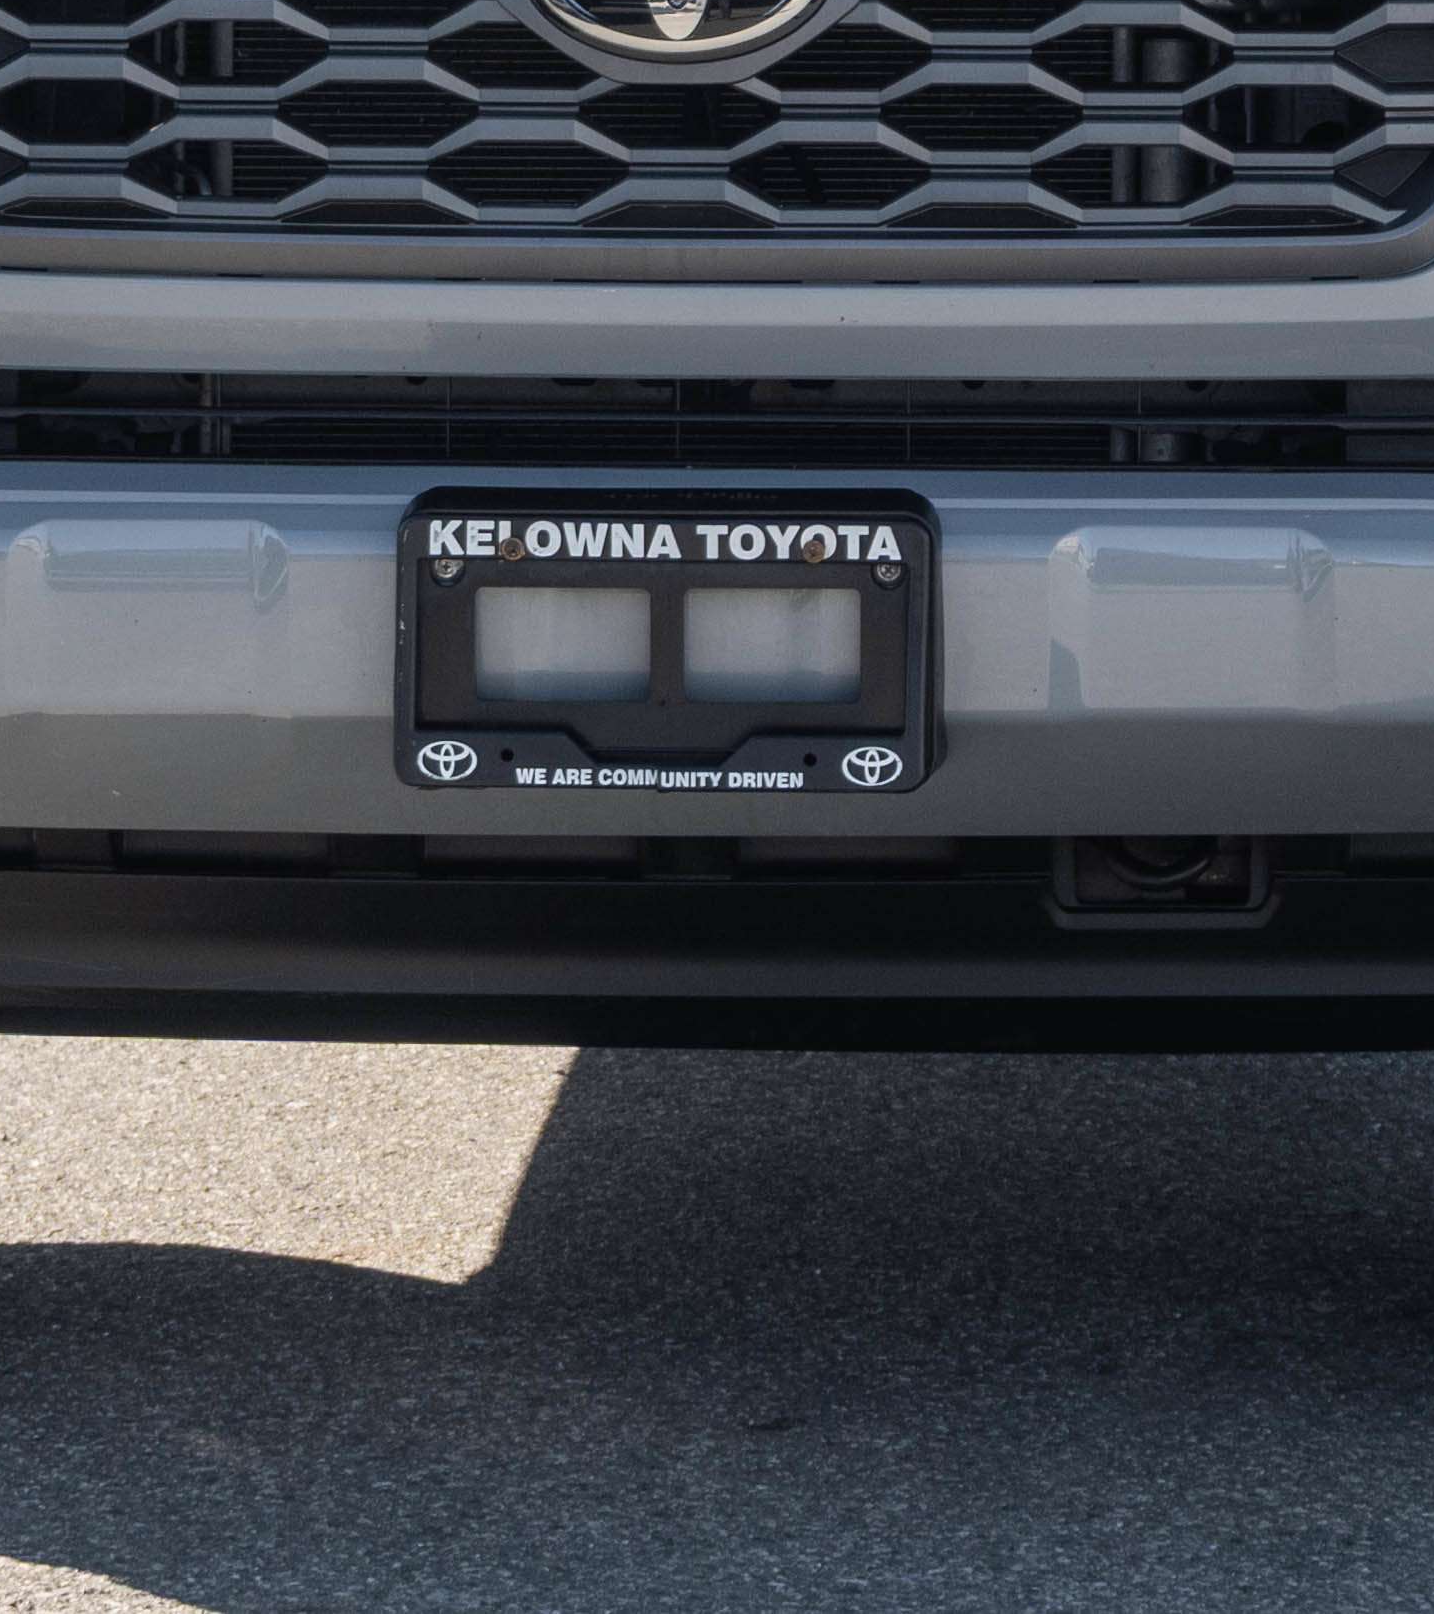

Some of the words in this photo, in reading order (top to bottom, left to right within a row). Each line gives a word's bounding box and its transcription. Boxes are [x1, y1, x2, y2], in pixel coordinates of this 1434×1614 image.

[696, 524, 902, 561] TOYOTA
[516, 768, 546, 785] WE
[552, 768, 593, 785] ARE
[598, 768, 722, 788] COMMUNITY
[728, 773, 804, 788] DRIVEN
